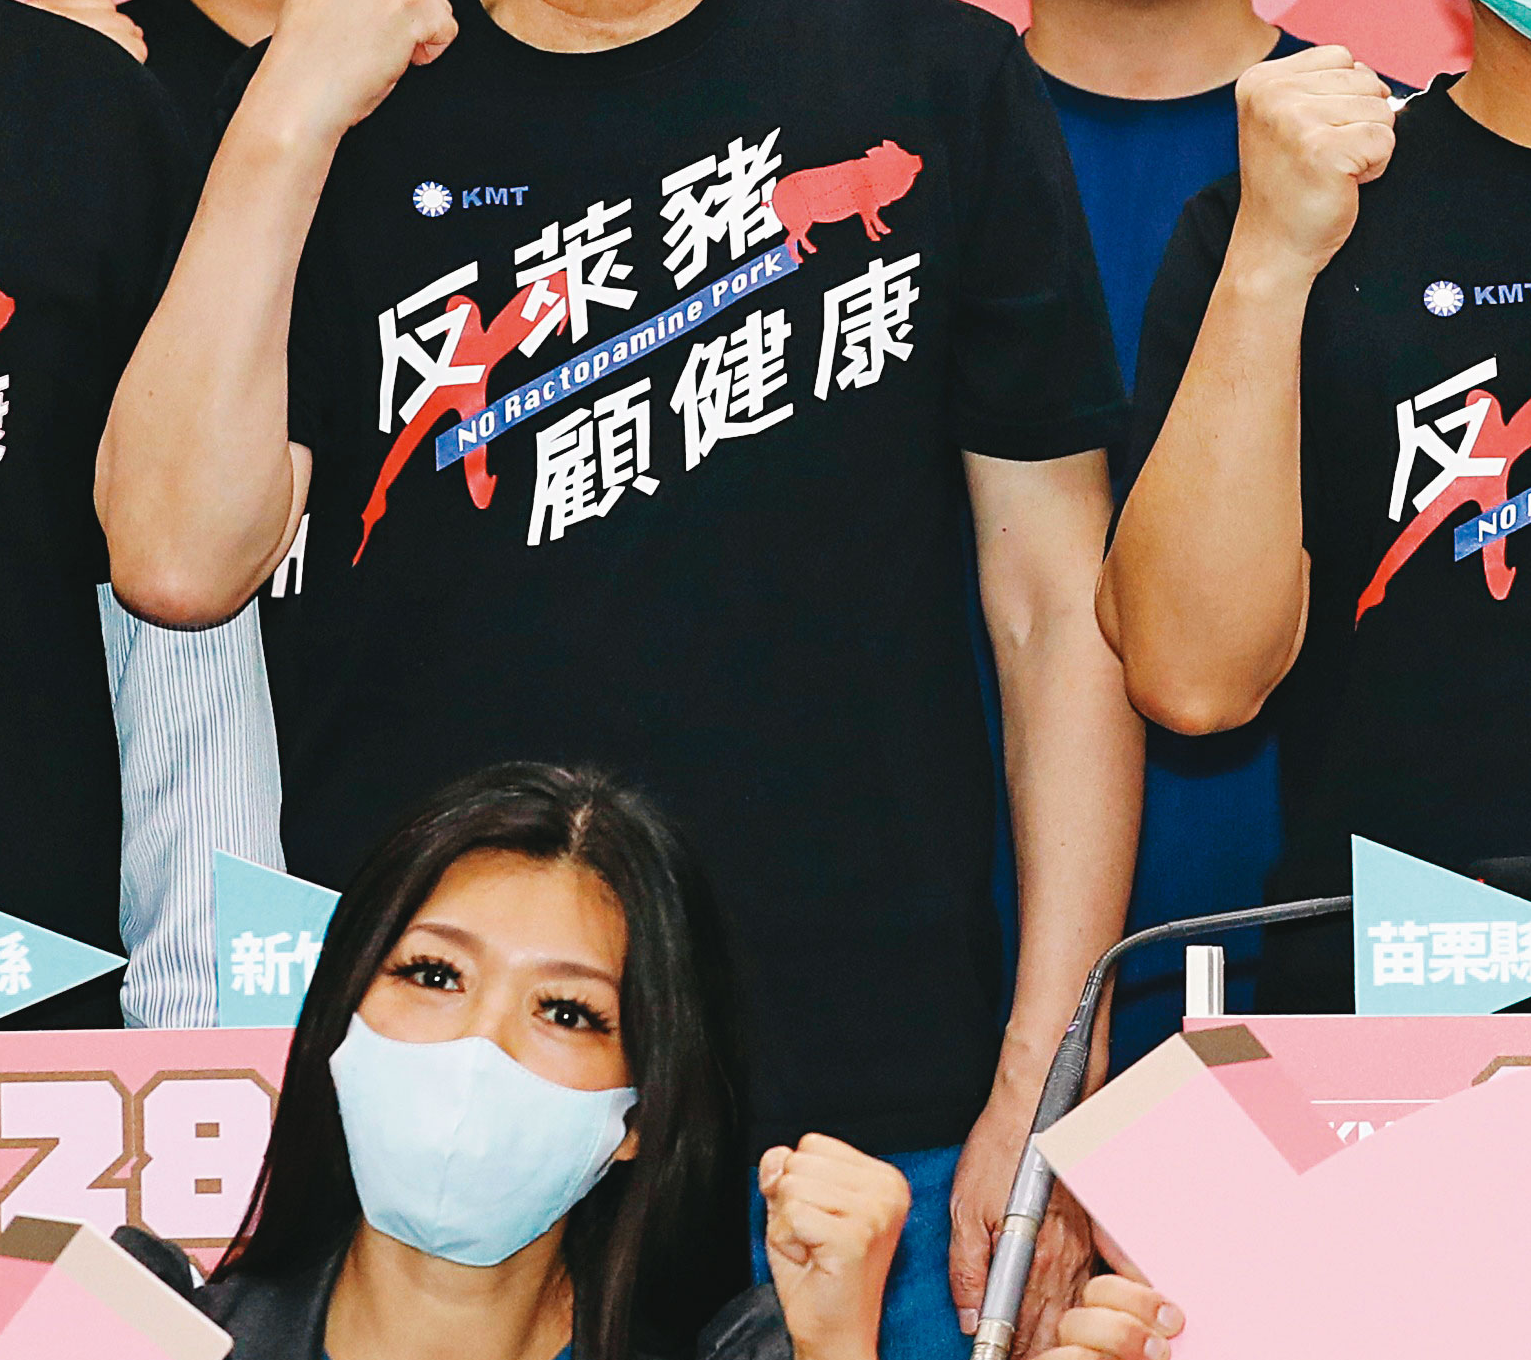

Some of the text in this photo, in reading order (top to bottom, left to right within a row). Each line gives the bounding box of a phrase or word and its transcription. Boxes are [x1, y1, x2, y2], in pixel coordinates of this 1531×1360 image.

[378, 127, 789, 434] 反萊豬
[461, 184, 529, 209] KMT
[456, 251, 785, 452] NO Ractopamine Pork
[527, 252, 922, 547] 顧健康
[1477, 505, 1519, 543] NO
